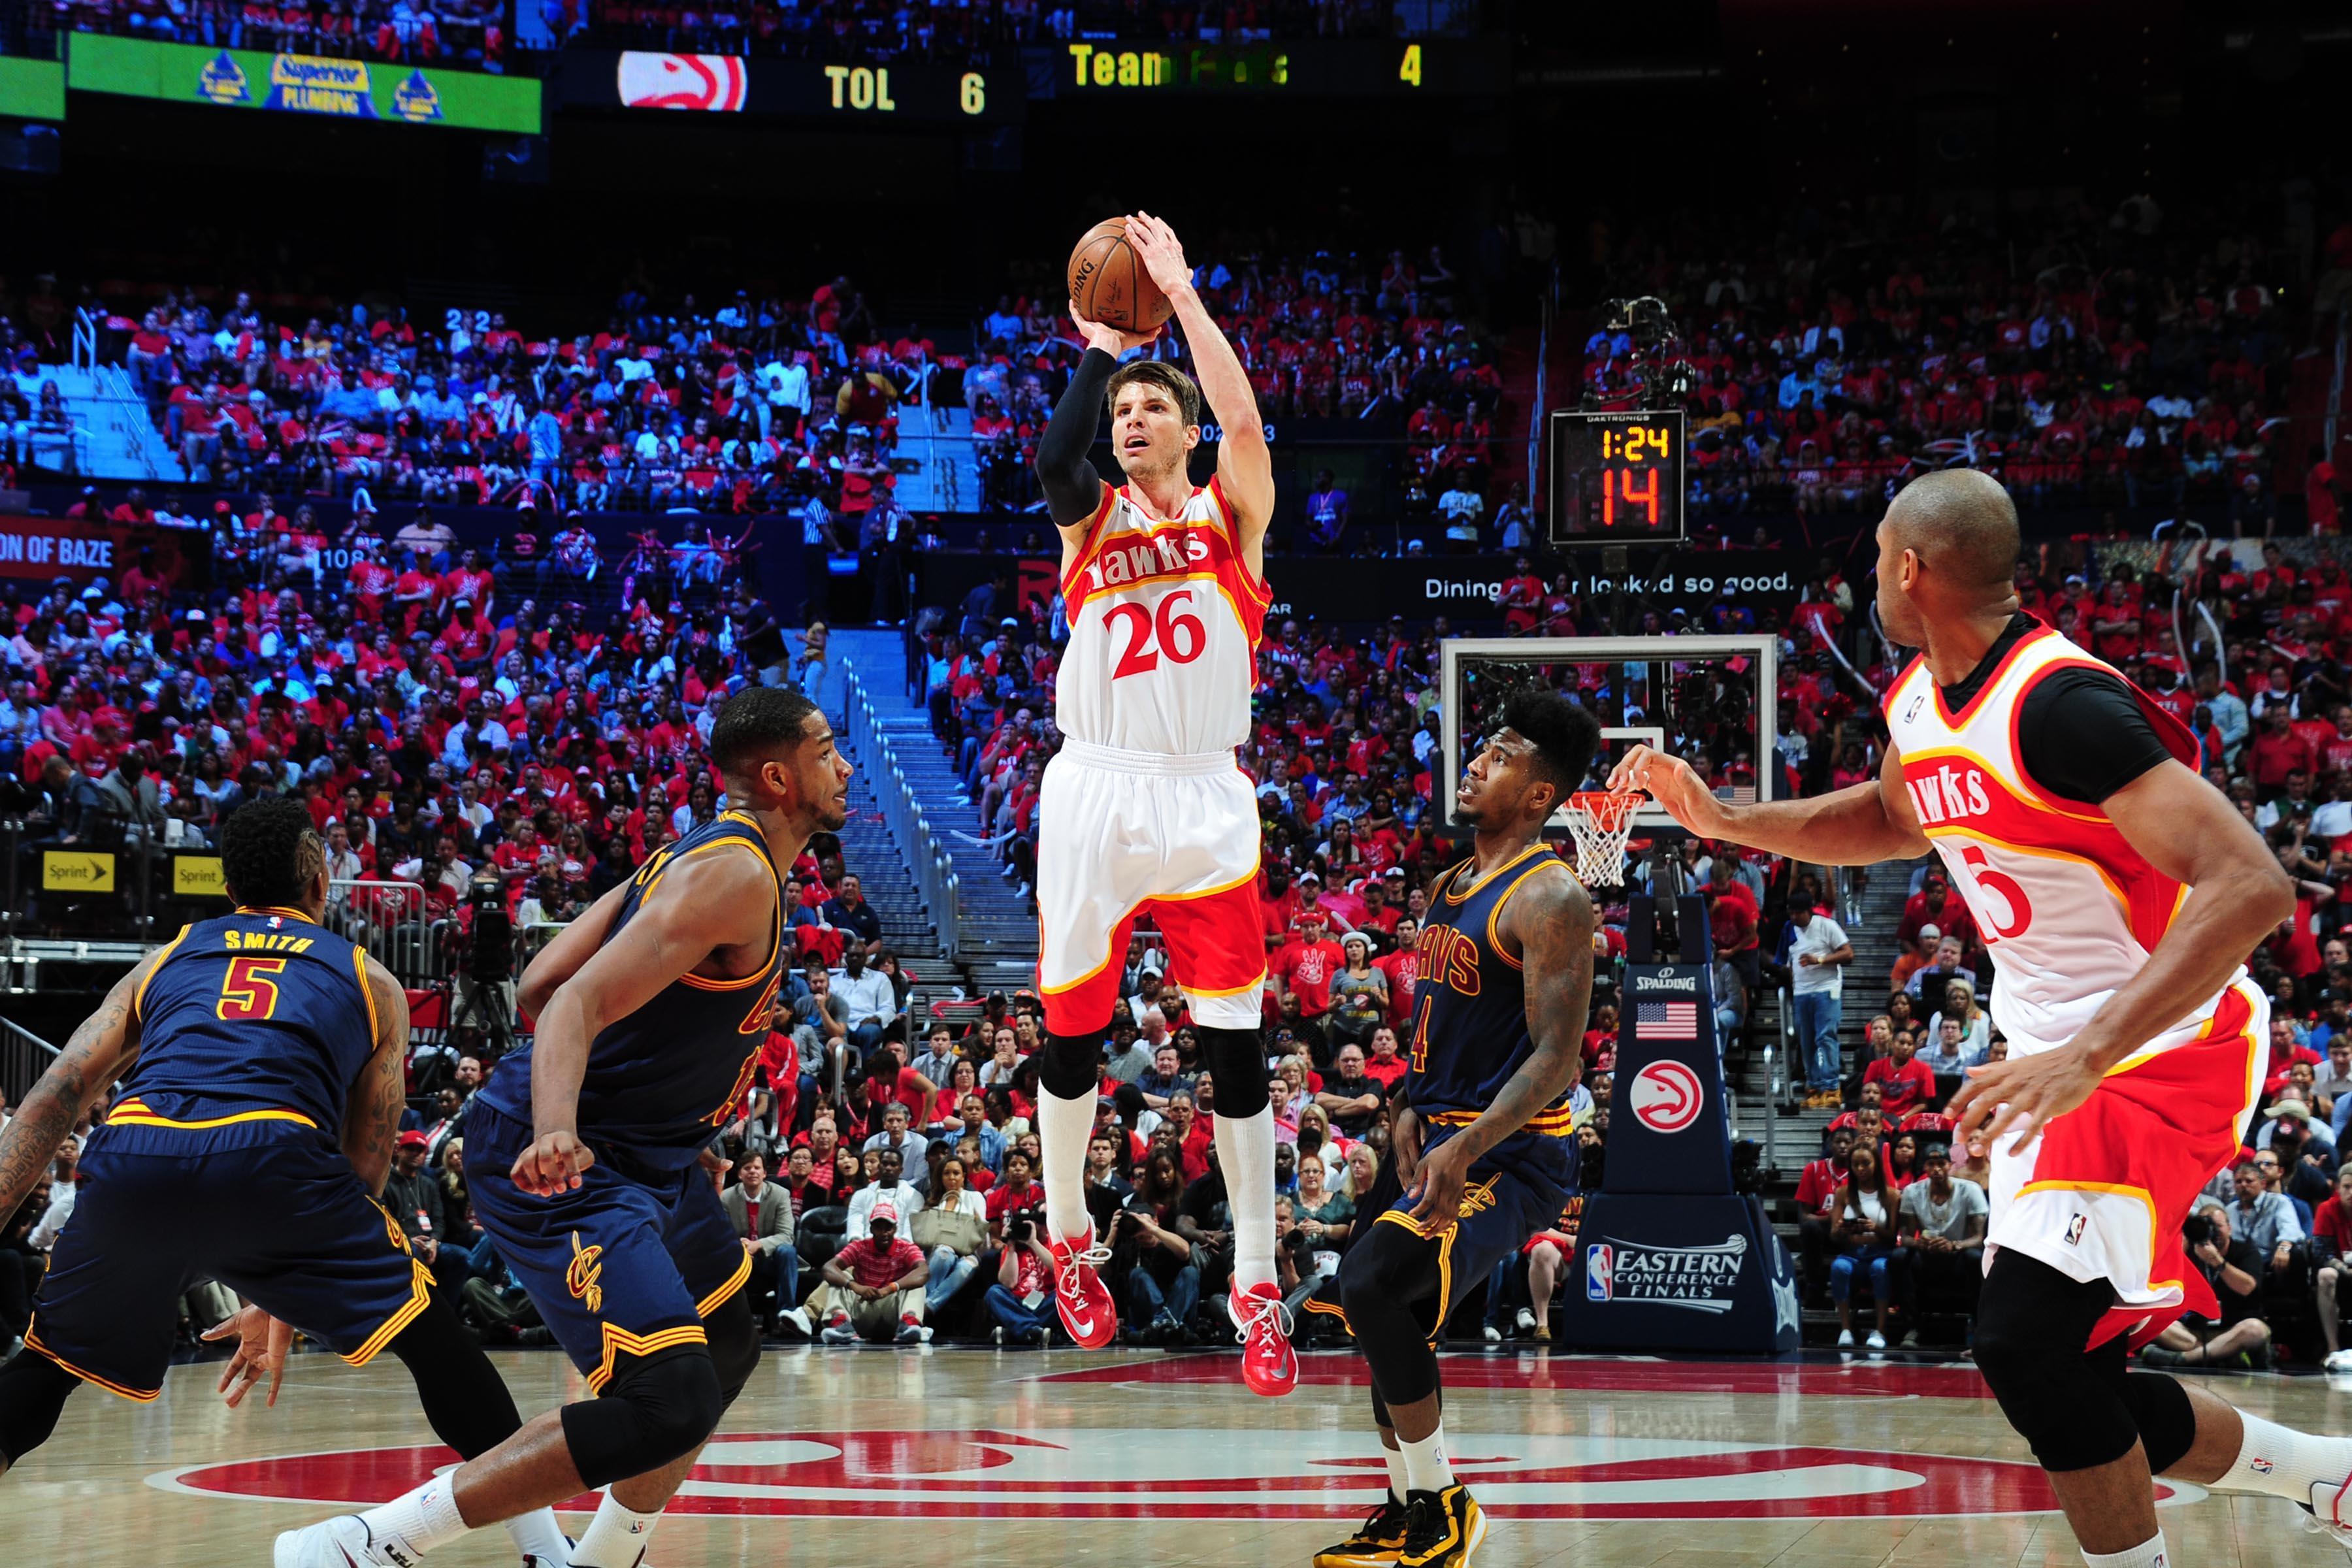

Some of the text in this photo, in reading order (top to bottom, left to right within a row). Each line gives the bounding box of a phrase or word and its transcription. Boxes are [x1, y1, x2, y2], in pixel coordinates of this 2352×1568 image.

[281, 56, 361, 84] Superior
[1400, 44, 1421, 86] 4
[282, 86, 359, 114] PLUMBING
[825, 65, 985, 114] TOL 6
[446, 308, 491, 333] 22
[1603, 427, 1669, 461] 1:24
[1603, 467, 1658, 526] 14
[27, 535, 55, 563] OF
[59, 537, 114, 568] BAZE
[1426, 579, 1503, 602] Dining
[1684, 577, 1714, 593] so
[1102, 590, 1207, 681] 26
[49, 864, 89, 881] Sprint
[180, 868, 218, 884] Sprint
[225, 930, 314, 953] SMITH
[216, 956, 287, 1021] 5
[1636, 976, 1696, 991] SPALDING
[1411, 994, 1432, 1073] 4
[1615, 1250, 1743, 1274] EASTERN
[1614, 1272, 1737, 1286] CONFERENCE
[1630, 1284, 1713, 1298] FINALS
